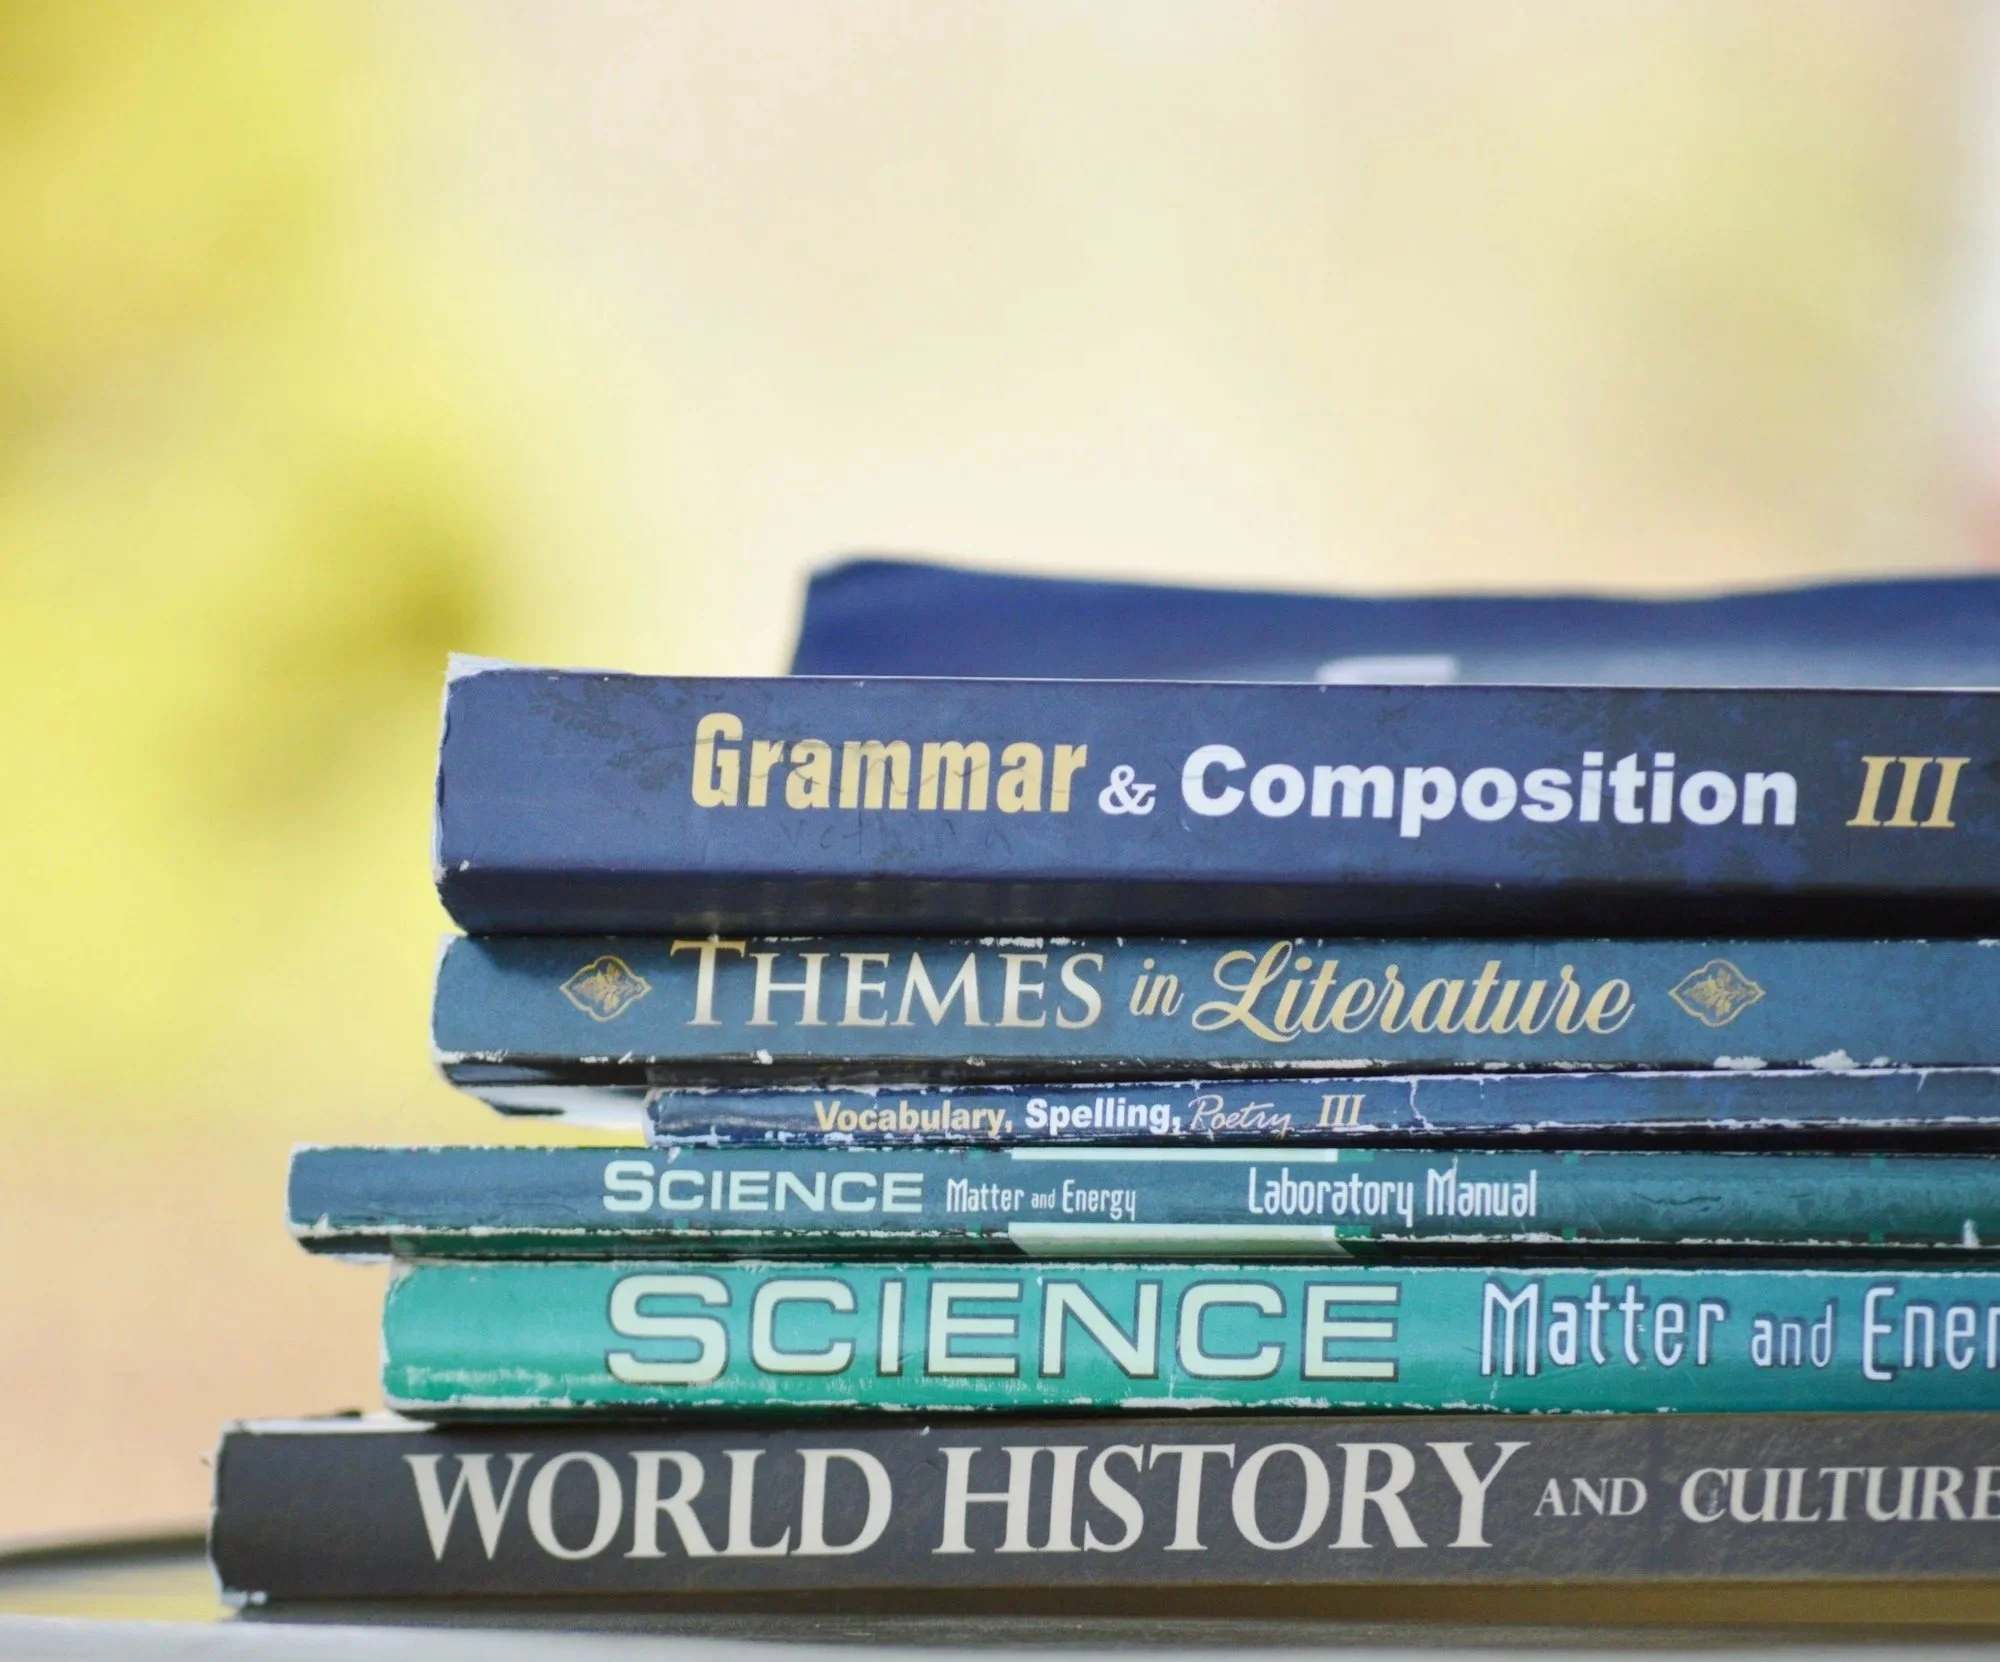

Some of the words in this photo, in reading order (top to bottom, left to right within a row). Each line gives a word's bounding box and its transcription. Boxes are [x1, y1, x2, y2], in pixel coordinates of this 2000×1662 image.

[692, 712, 1087, 813] Grammar
[1098, 764, 1156, 816] &
[1181, 743, 1797, 838] Composition
[1846, 755, 1971, 828] III
[670, 939, 1104, 1029] THEMES
[1130, 958, 1184, 1016] in
[1191, 940, 1636, 1043] Literature
[815, 1098, 1013, 1137] Vocabulary,
[1025, 1097, 1182, 1134] Spelling,
[1188, 1095, 1295, 1138] Poetry
[1318, 1095, 1366, 1127] III
[603, 1160, 924, 1213] SCIENCE
[946, 1178, 1024, 1213] Matter
[1031, 1188, 1056, 1211] and
[1061, 1179, 1136, 1221] Energy
[1248, 1167, 1414, 1227] Laboratory
[1426, 1168, 1538, 1217] Manual
[604, 1273, 1400, 1386] SCIENCE
[1480, 1281, 1725, 1376] Matter
[1751, 1304, 1834, 1368] and
[403, 1449, 892, 1562] WORLD
[932, 1440, 1531, 1556] HISTORY
[1534, 1477, 1647, 1517] AND
[1680, 1465, 2000, 1524] CULTURE
